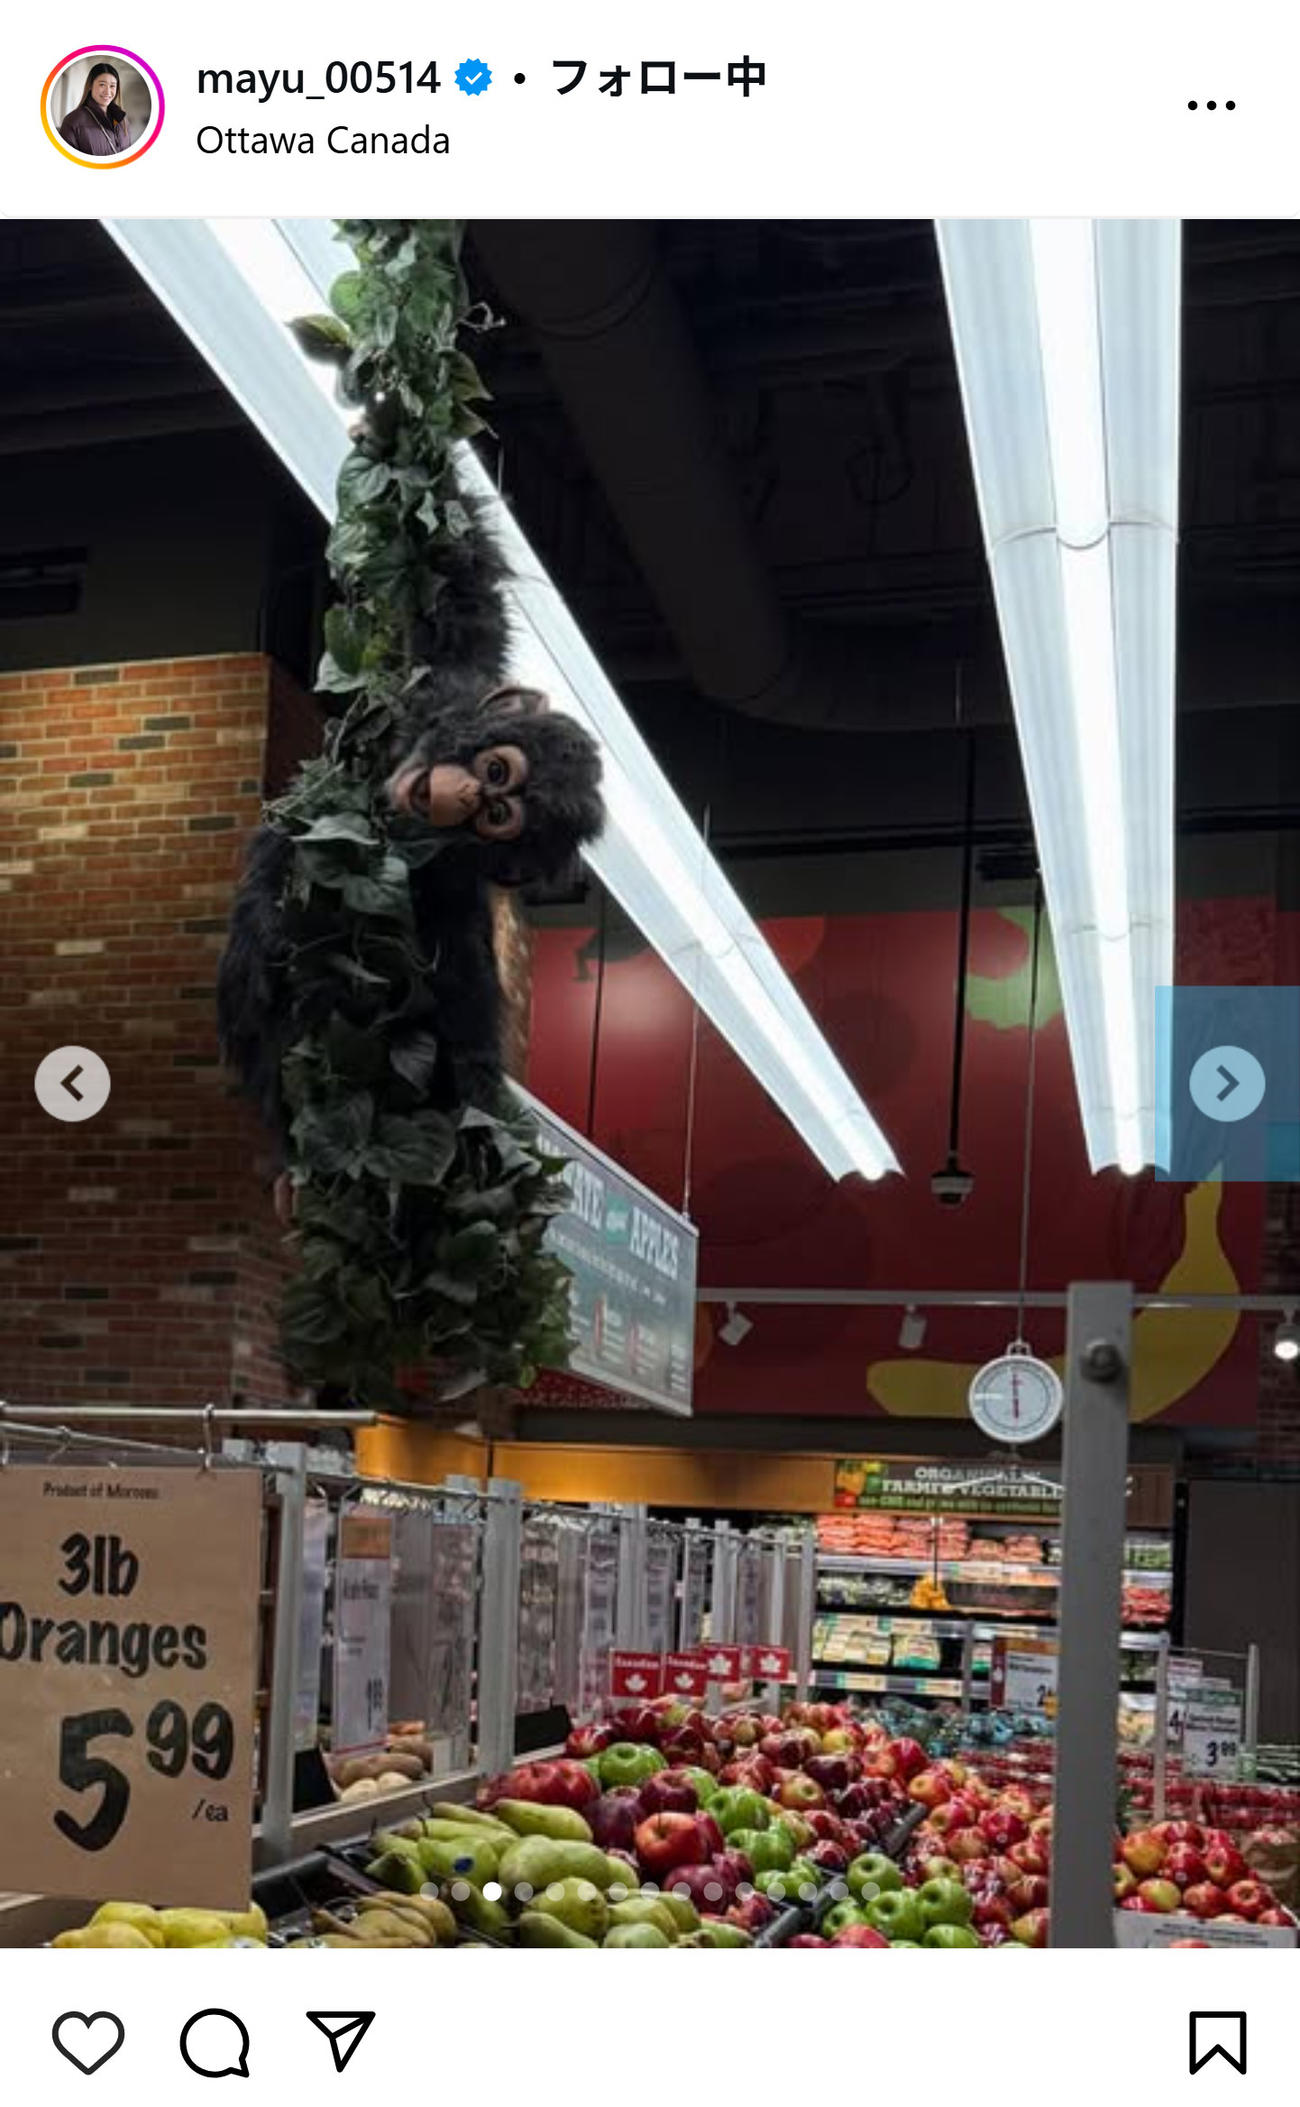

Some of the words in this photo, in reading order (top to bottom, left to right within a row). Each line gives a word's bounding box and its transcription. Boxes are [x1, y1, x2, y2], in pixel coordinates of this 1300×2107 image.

[630, 1206, 680, 1281] APPLES
[42, 1482, 88, 1498] Product
[90, 1482, 104, 1498] of
[58, 1532, 139, 1597] 3lb
[0, 1601, 208, 1679] Oranges
